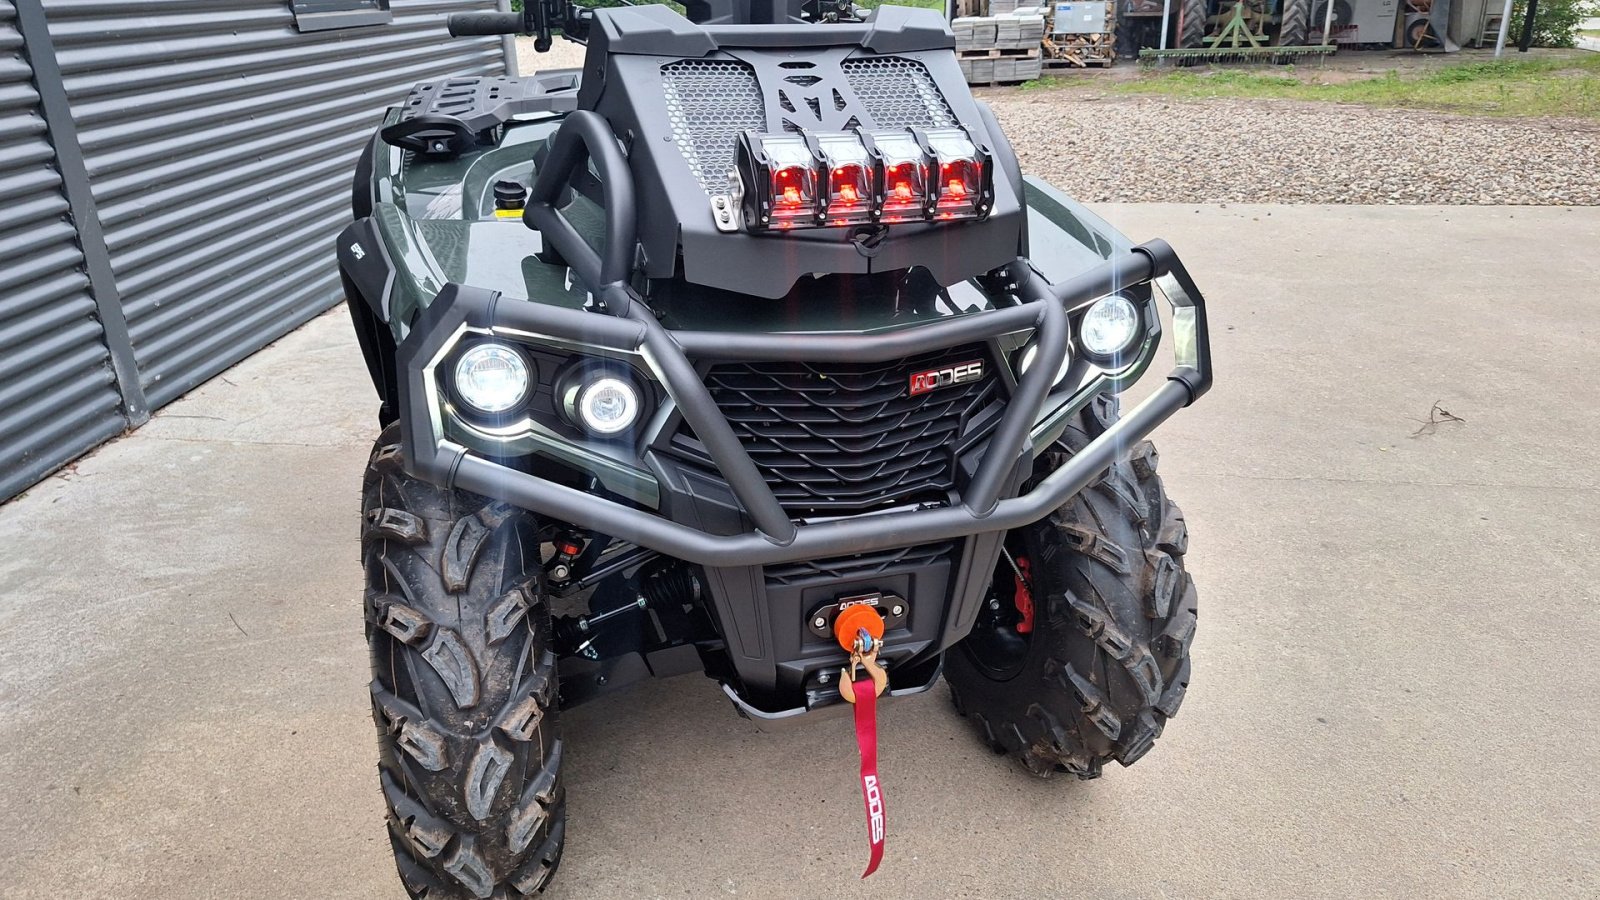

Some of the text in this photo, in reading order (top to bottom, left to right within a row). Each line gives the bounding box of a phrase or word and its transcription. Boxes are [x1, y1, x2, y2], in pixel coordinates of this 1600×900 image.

[350, 243, 365, 260] EPS
[911, 362, 982, 392] AODES
[864, 775, 884, 845] AODES
